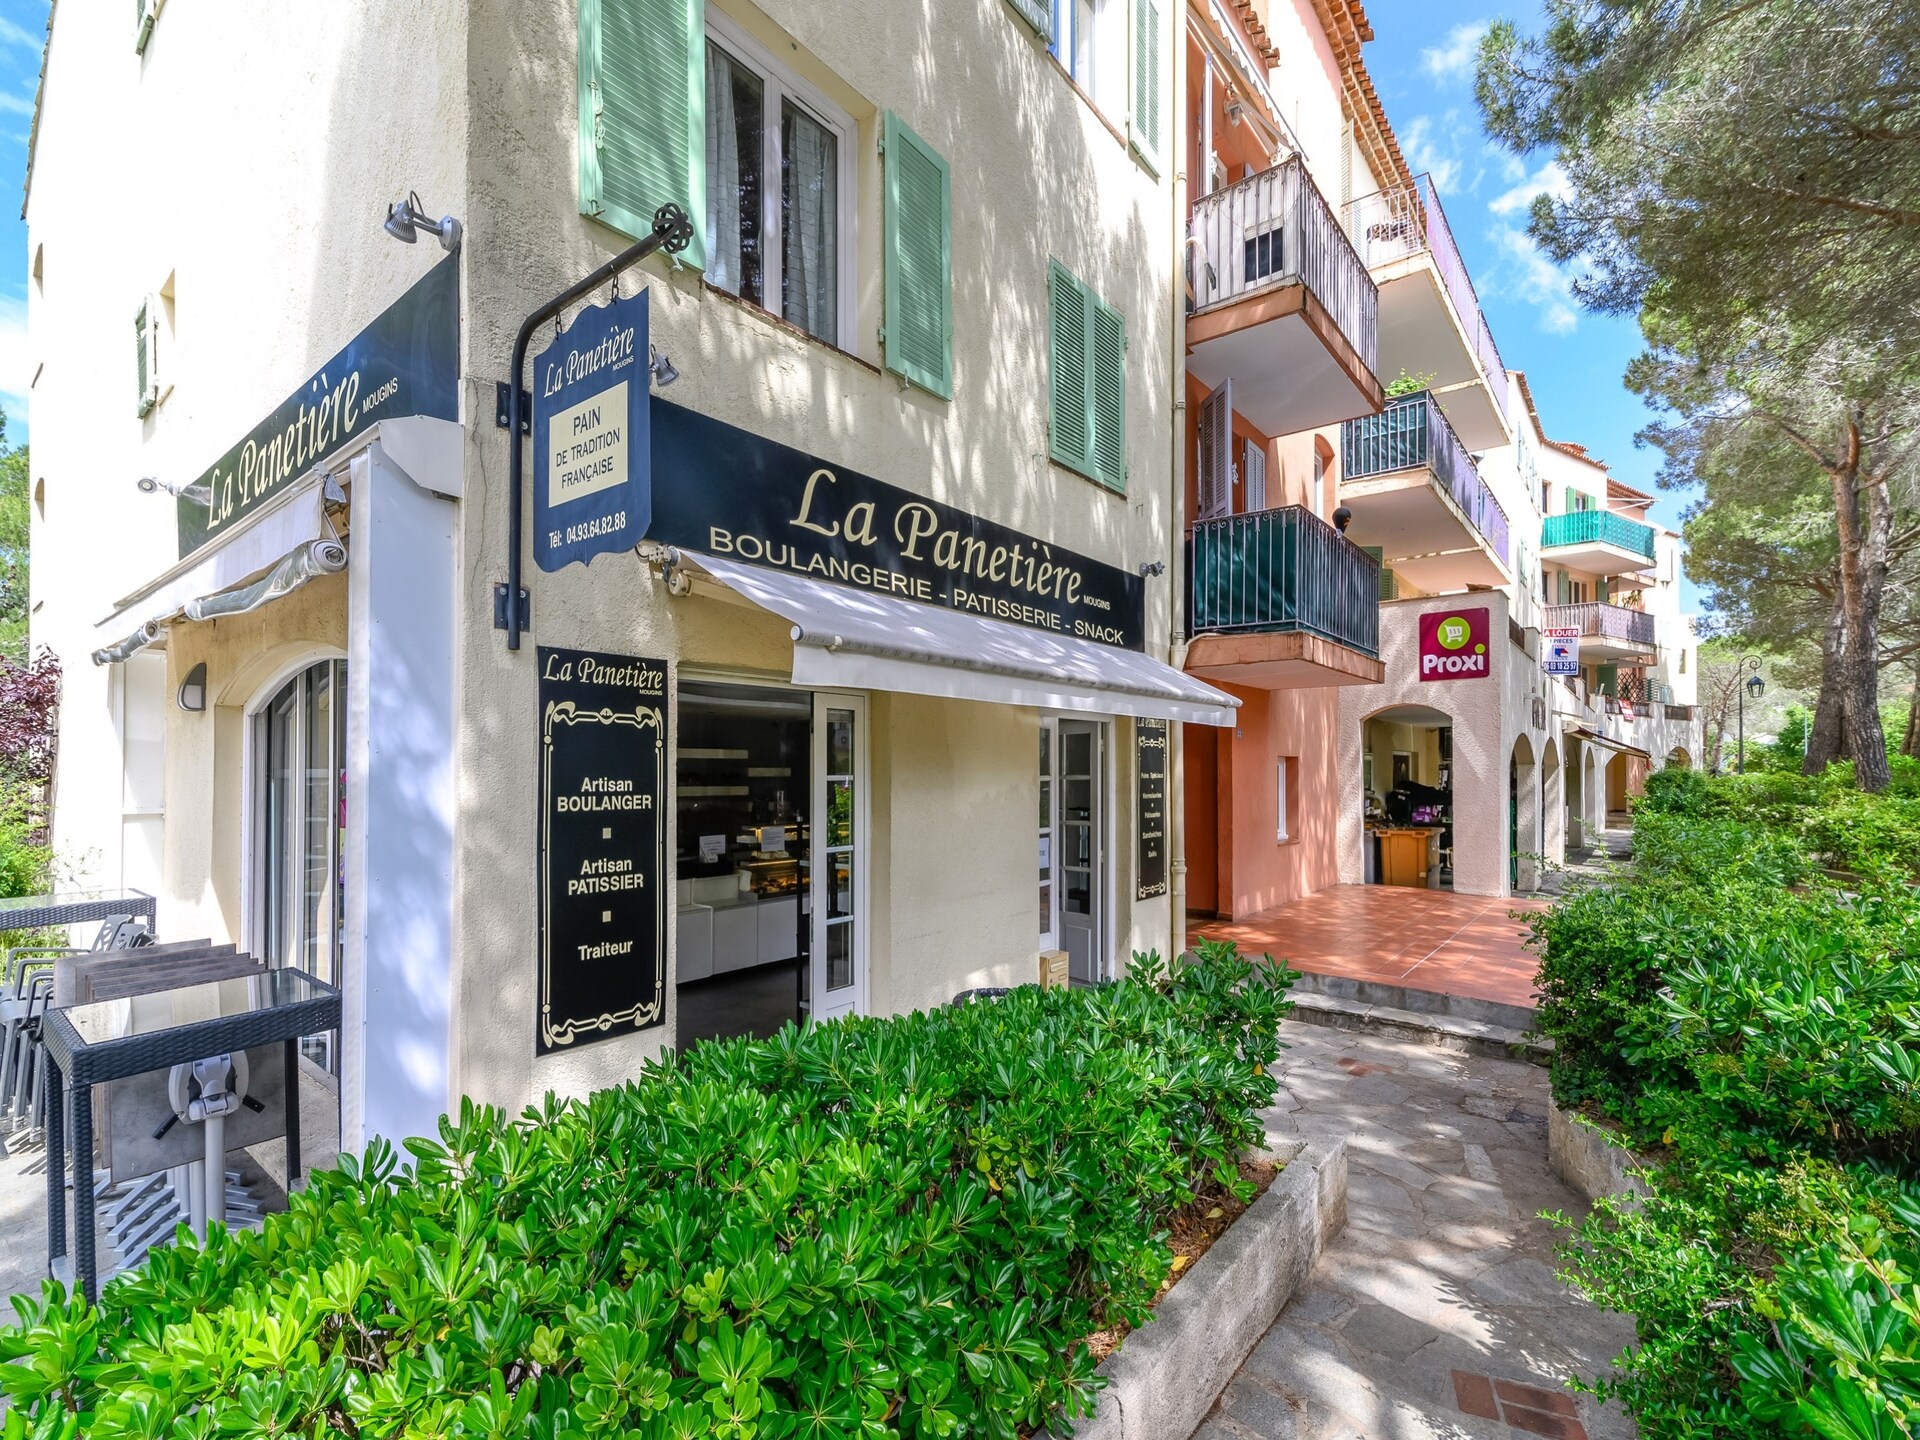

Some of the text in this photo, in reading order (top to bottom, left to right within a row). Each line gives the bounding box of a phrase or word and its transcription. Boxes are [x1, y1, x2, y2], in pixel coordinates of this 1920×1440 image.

[543, 325, 635, 398] La Panetière
[612, 355, 635, 372] MOUGINS
[572, 406, 601, 437] PAIN
[206, 371, 399, 531] La Panetière MOUGINS
[556, 427, 621, 468] DE TRADITION
[561, 456, 614, 490] FRANÇAISE
[548, 510, 627, 549] Tél: 04.93.64.82.88
[789, 469, 1111, 611] La Panetière MOUGINS
[710, 526, 932, 600] BOULANGERIE
[953, 588, 1061, 630] PATISSERIE
[1074, 620, 1124, 645] SNACK
[1544, 629, 1578, 637] A LOUER
[543, 653, 663, 689] La Panetière
[1423, 643, 1486, 675] Proxi
[639, 688, 663, 696] MOUGINS
[581, 777, 633, 793] Artisan
[557, 795, 652, 812] BOULANGER
[580, 858, 632, 875] Artisan
[568, 873, 644, 896] PATISSIER
[578, 940, 633, 961] Traiteur
